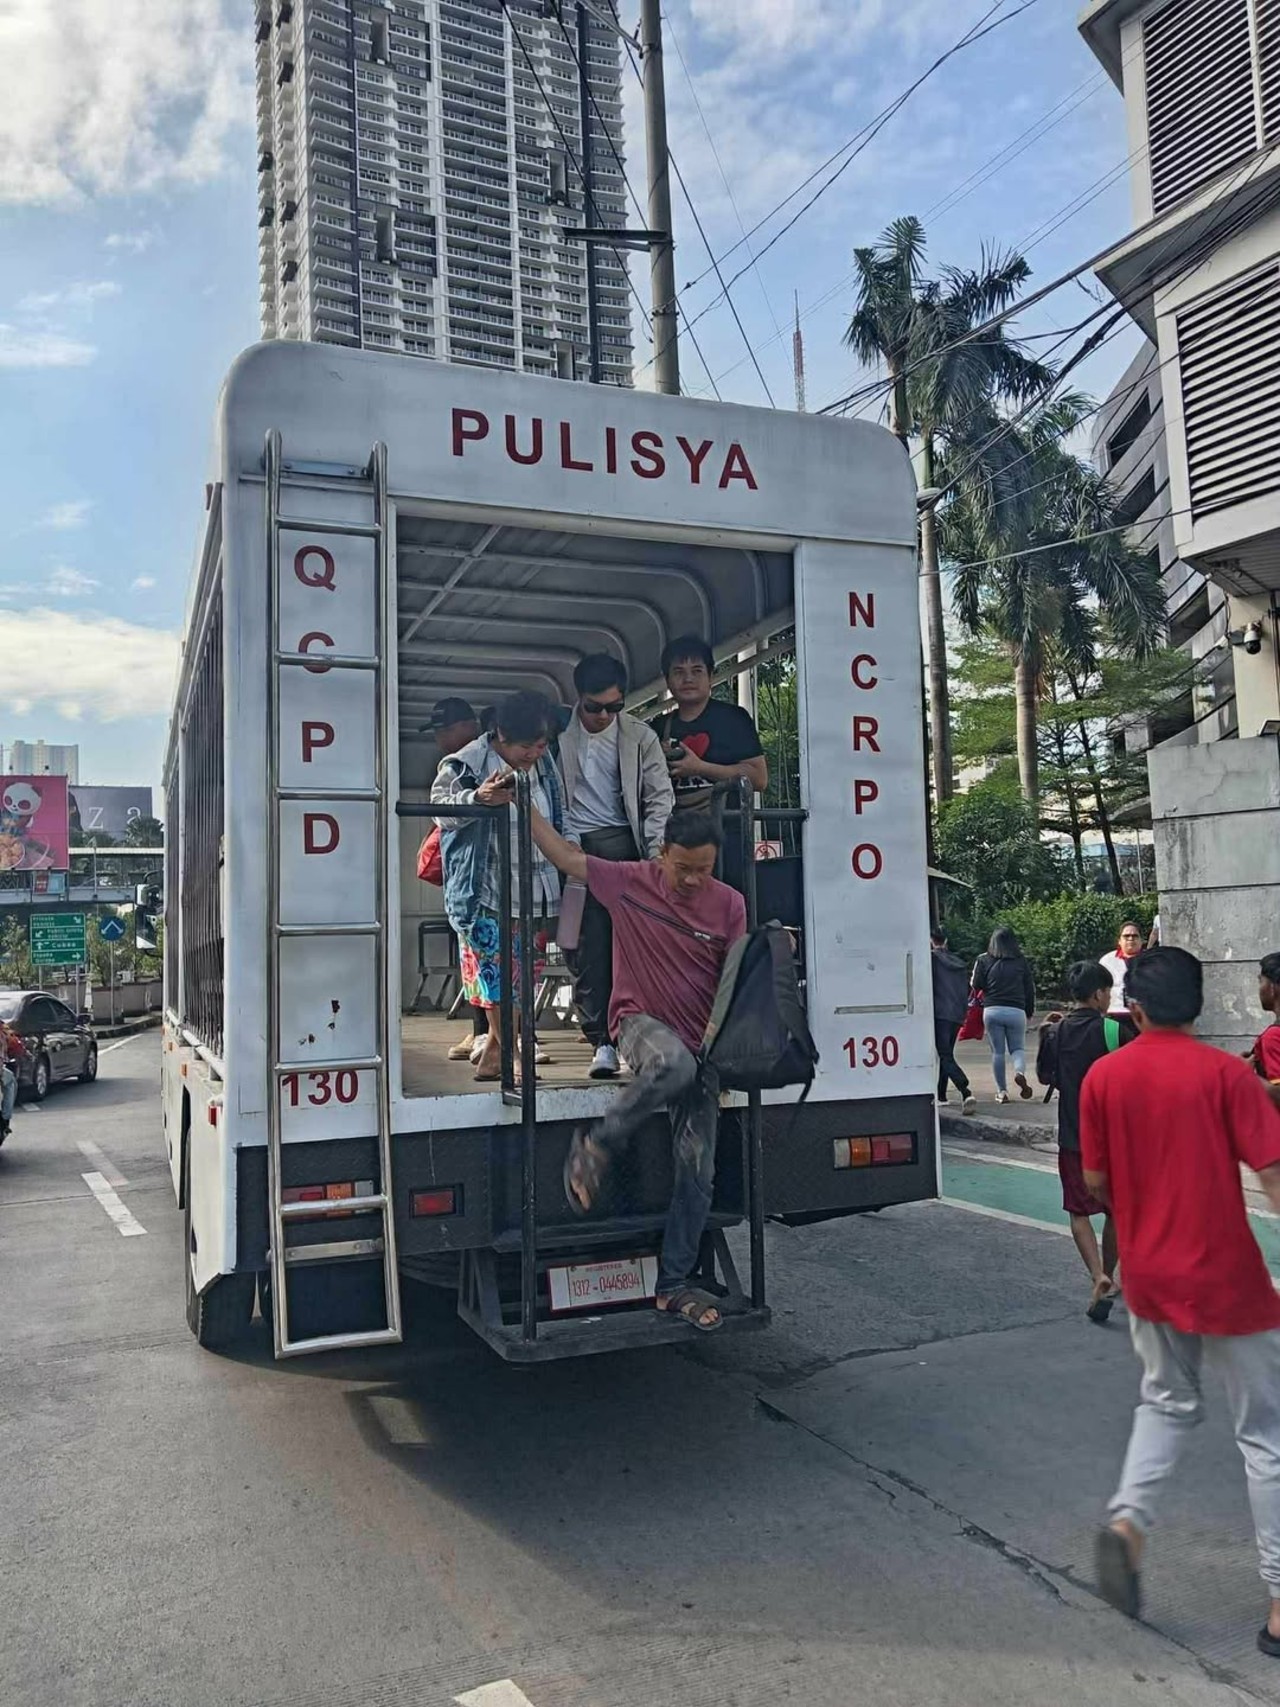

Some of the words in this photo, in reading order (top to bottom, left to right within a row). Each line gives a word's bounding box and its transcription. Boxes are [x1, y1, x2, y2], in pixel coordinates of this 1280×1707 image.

[452, 407, 758, 490] PULISYA
[849, 591, 883, 880] NCRPO
[843, 1035, 899, 1069] 130
[282, 1071, 359, 1106] 130
